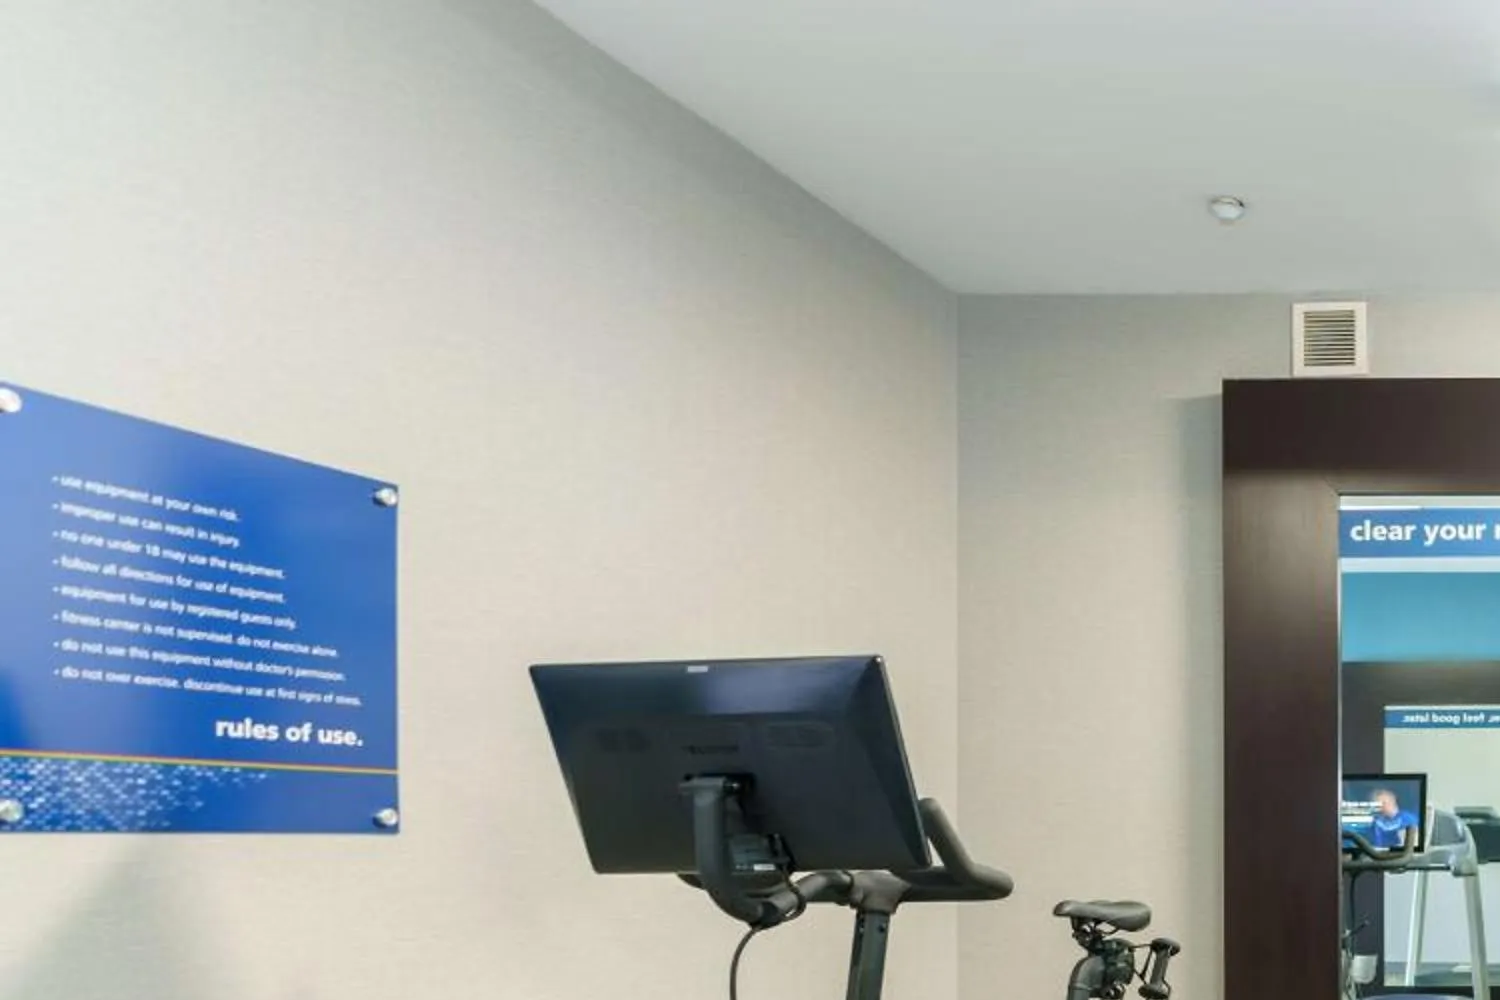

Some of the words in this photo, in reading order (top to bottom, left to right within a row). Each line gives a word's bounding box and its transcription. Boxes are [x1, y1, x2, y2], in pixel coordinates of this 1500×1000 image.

[61, 476, 82, 489] use
[85, 480, 149, 503] equipment
[165, 498, 190, 512] your
[118, 515, 139, 527] use
[141, 518, 162, 532] can
[1350, 520, 1417, 541] clear
[1423, 525, 1488, 546] your
[61, 530, 79, 544] no
[80, 533, 104, 548] one
[107, 538, 142, 554] under
[145, 543, 160, 557] 18
[162, 549, 186, 564] may
[187, 554, 207, 565] use
[61, 555, 99, 574] follow
[176, 574, 193, 588] for
[195, 581, 214, 592] use
[216, 582, 228, 594] of
[129, 592, 146, 607] for
[148, 599, 169, 611] use
[171, 600, 185, 616] by
[154, 624, 175, 637] not
[61, 639, 80, 653] do
[81, 641, 103, 655] not
[104, 645, 126, 658] use
[61, 666, 80, 679] do
[81, 669, 103, 682] not
[245, 687, 264, 698] use
[215, 717, 279, 741] rules
[285, 724, 312, 744] of
[317, 729, 363, 747] use.
